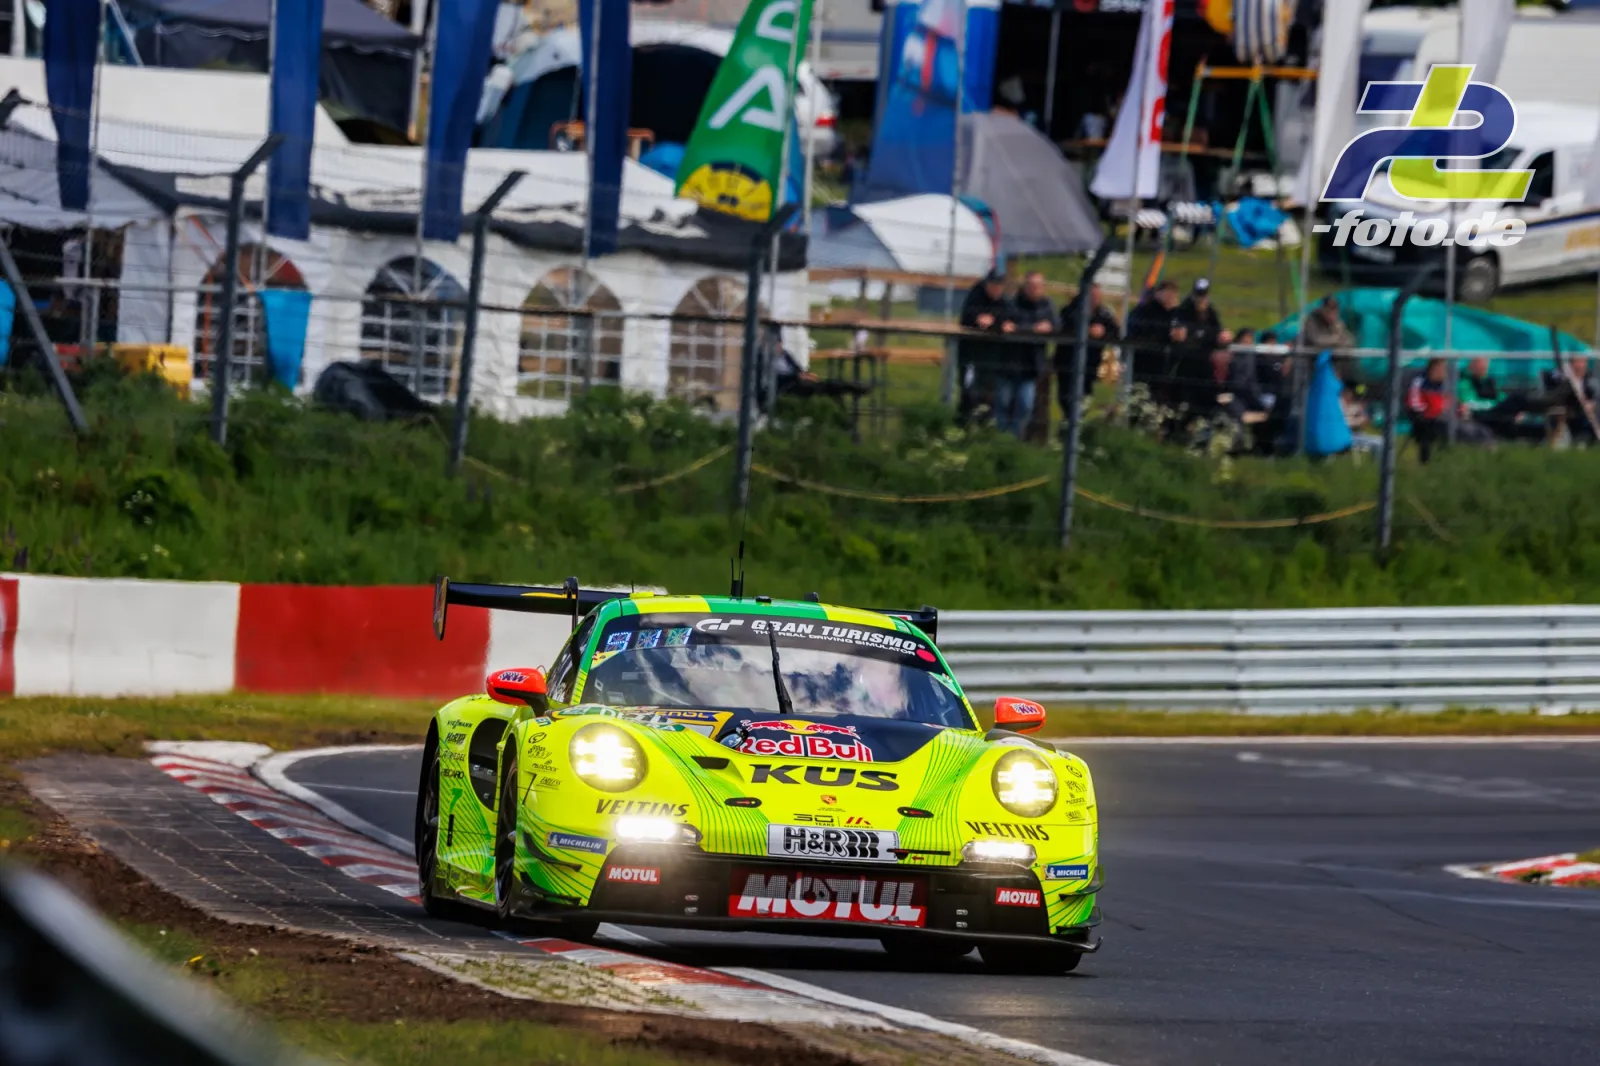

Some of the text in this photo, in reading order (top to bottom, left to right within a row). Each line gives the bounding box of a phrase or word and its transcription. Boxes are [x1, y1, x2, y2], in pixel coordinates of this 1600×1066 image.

[750, 619, 811, 634] GRAN
[778, 631, 807, 639] REAL
[808, 634, 854, 644] DRIVING
[854, 640, 917, 656] SIMULATOR
[736, 735, 873, 763] Red Bull
[749, 763, 900, 791] KÜS
[595, 799, 690, 817] VELTINS
[965, 820, 1050, 841] VELTINS
[559, 838, 602, 850] MICHELIN
[783, 826, 848, 857] H&R
[608, 867, 658, 882] MOTUL
[1056, 869, 1087, 877] MICHELIN
[736, 872, 922, 922] MOTUL
[997, 890, 1039, 905] MOTUL
